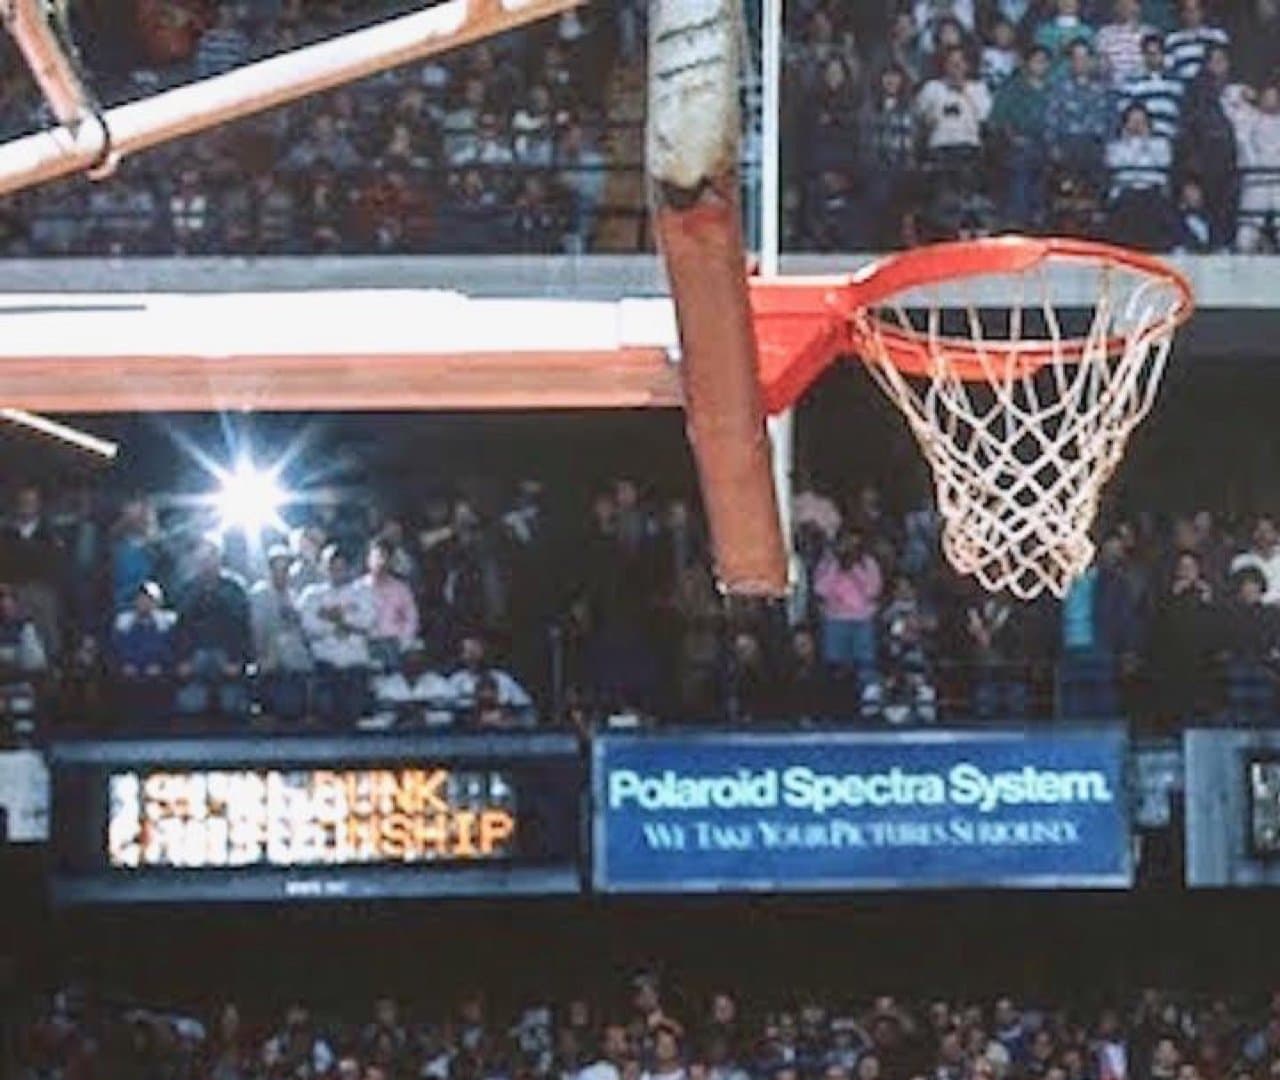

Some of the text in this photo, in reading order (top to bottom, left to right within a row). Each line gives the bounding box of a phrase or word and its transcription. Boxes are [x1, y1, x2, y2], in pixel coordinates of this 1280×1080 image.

[609, 762, 1112, 814] Polaroid Spectra System.
